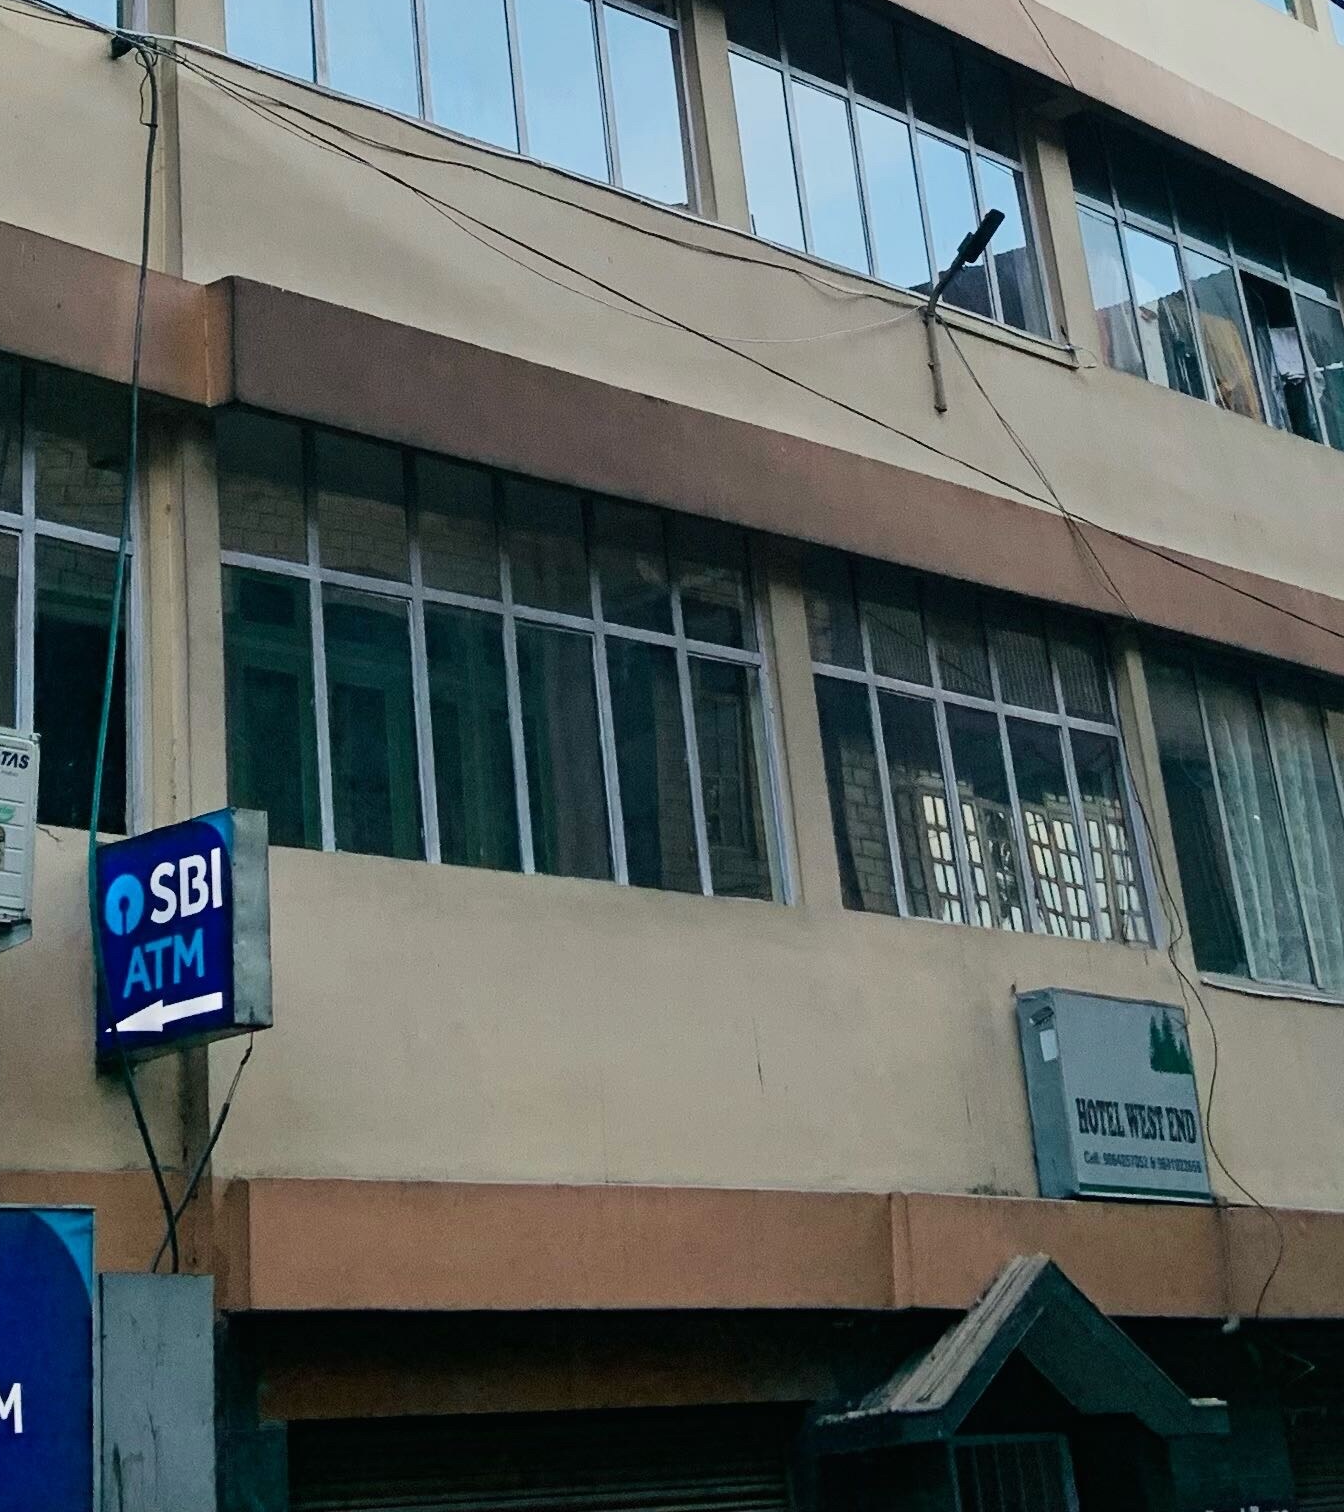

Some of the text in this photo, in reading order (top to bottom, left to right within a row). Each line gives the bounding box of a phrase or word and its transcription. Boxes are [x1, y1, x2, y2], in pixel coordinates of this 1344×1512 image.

[149, 847, 223, 924] SBI
[122, 928, 205, 999] ATM
[1075, 1097, 1198, 1144] HOTEL WEST END
